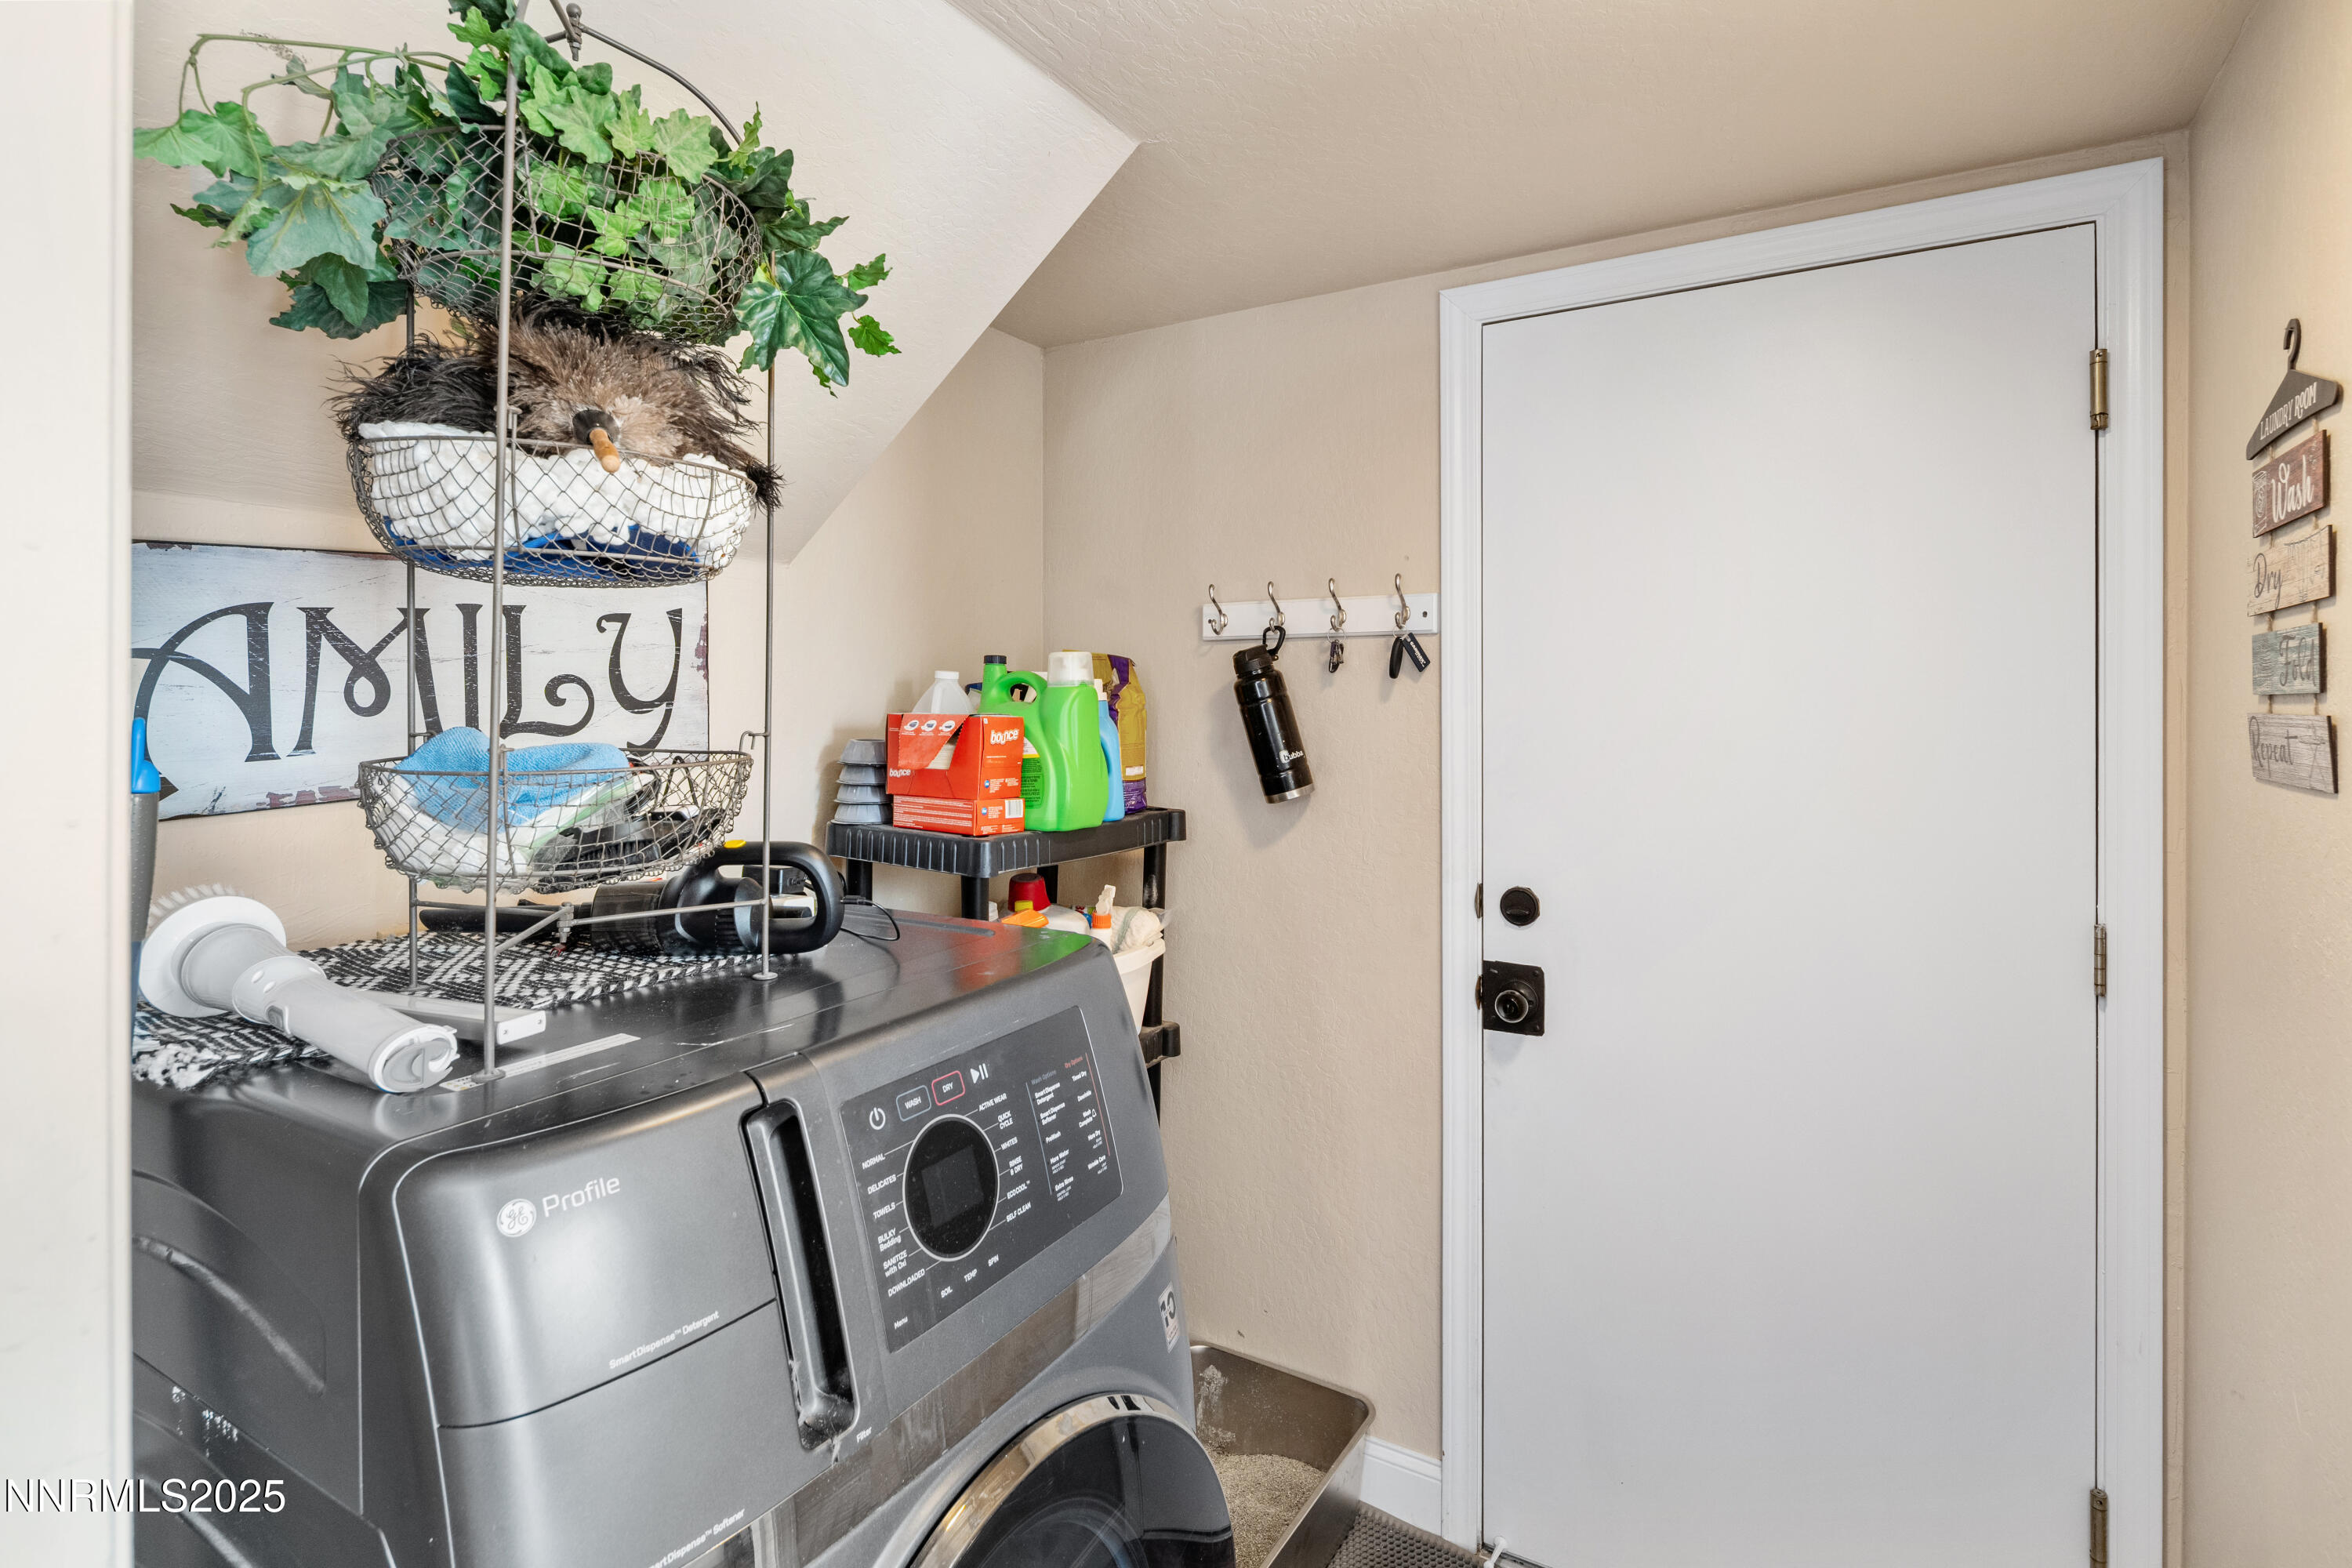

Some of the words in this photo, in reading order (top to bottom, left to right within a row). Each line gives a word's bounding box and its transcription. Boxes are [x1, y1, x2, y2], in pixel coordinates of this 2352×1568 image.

[2259, 399, 2293, 440] LAUNDRY
[2294, 382, 2318, 419] ROOM
[2271, 455, 2314, 523] Wash
[2252, 553, 2284, 609] Dry
[2279, 635, 2317, 687] Fold
[990, 729, 1019, 745] bounce
[2249, 716, 2299, 778] Repeat
[1281, 750, 1304, 762] bubba
[889, 768, 911, 778] bounce
[942, 1082, 953, 1093] DRY
[905, 1096, 922, 1109] WASH
[979, 1098, 994, 1111] ACTIVE
[994, 1093, 1007, 1105] WEAR
[997, 1110, 1011, 1123] QUICK
[1000, 1117, 1014, 1130] CYCLE
[1000, 1137, 1018, 1150] WHITES
[862, 1153, 886, 1170] NORMAL
[1009, 1156, 1022, 1168] RINSE
[1014, 1163, 1023, 1174] DRY
[867, 1174, 897, 1195] DELICATES
[542, 1177, 620, 1218] Profile
[873, 1202, 896, 1219] TOWELS
[1006, 1210, 1017, 1222] SELF
[1017, 1201, 1031, 1216] CLEAN
[878, 1228, 896, 1244] BULKY
[879, 1236, 902, 1252] Bedding
[883, 1250, 908, 1269] SANITIZE
[885, 1265, 898, 1278] with
[898, 1258, 907, 1269] Oxi
[988, 1254, 1000, 1267] SPIN
[887, 1269, 925, 1298] DOWNLOADED
[964, 1269, 977, 1283] TEMP
[941, 1286, 953, 1298] SOIL
[682, 1310, 720, 1335] Detergent
[894, 1316, 908, 1330] Menu
[856, 1426, 872, 1443] Filter
[713, 1508, 745, 1535] Softener
